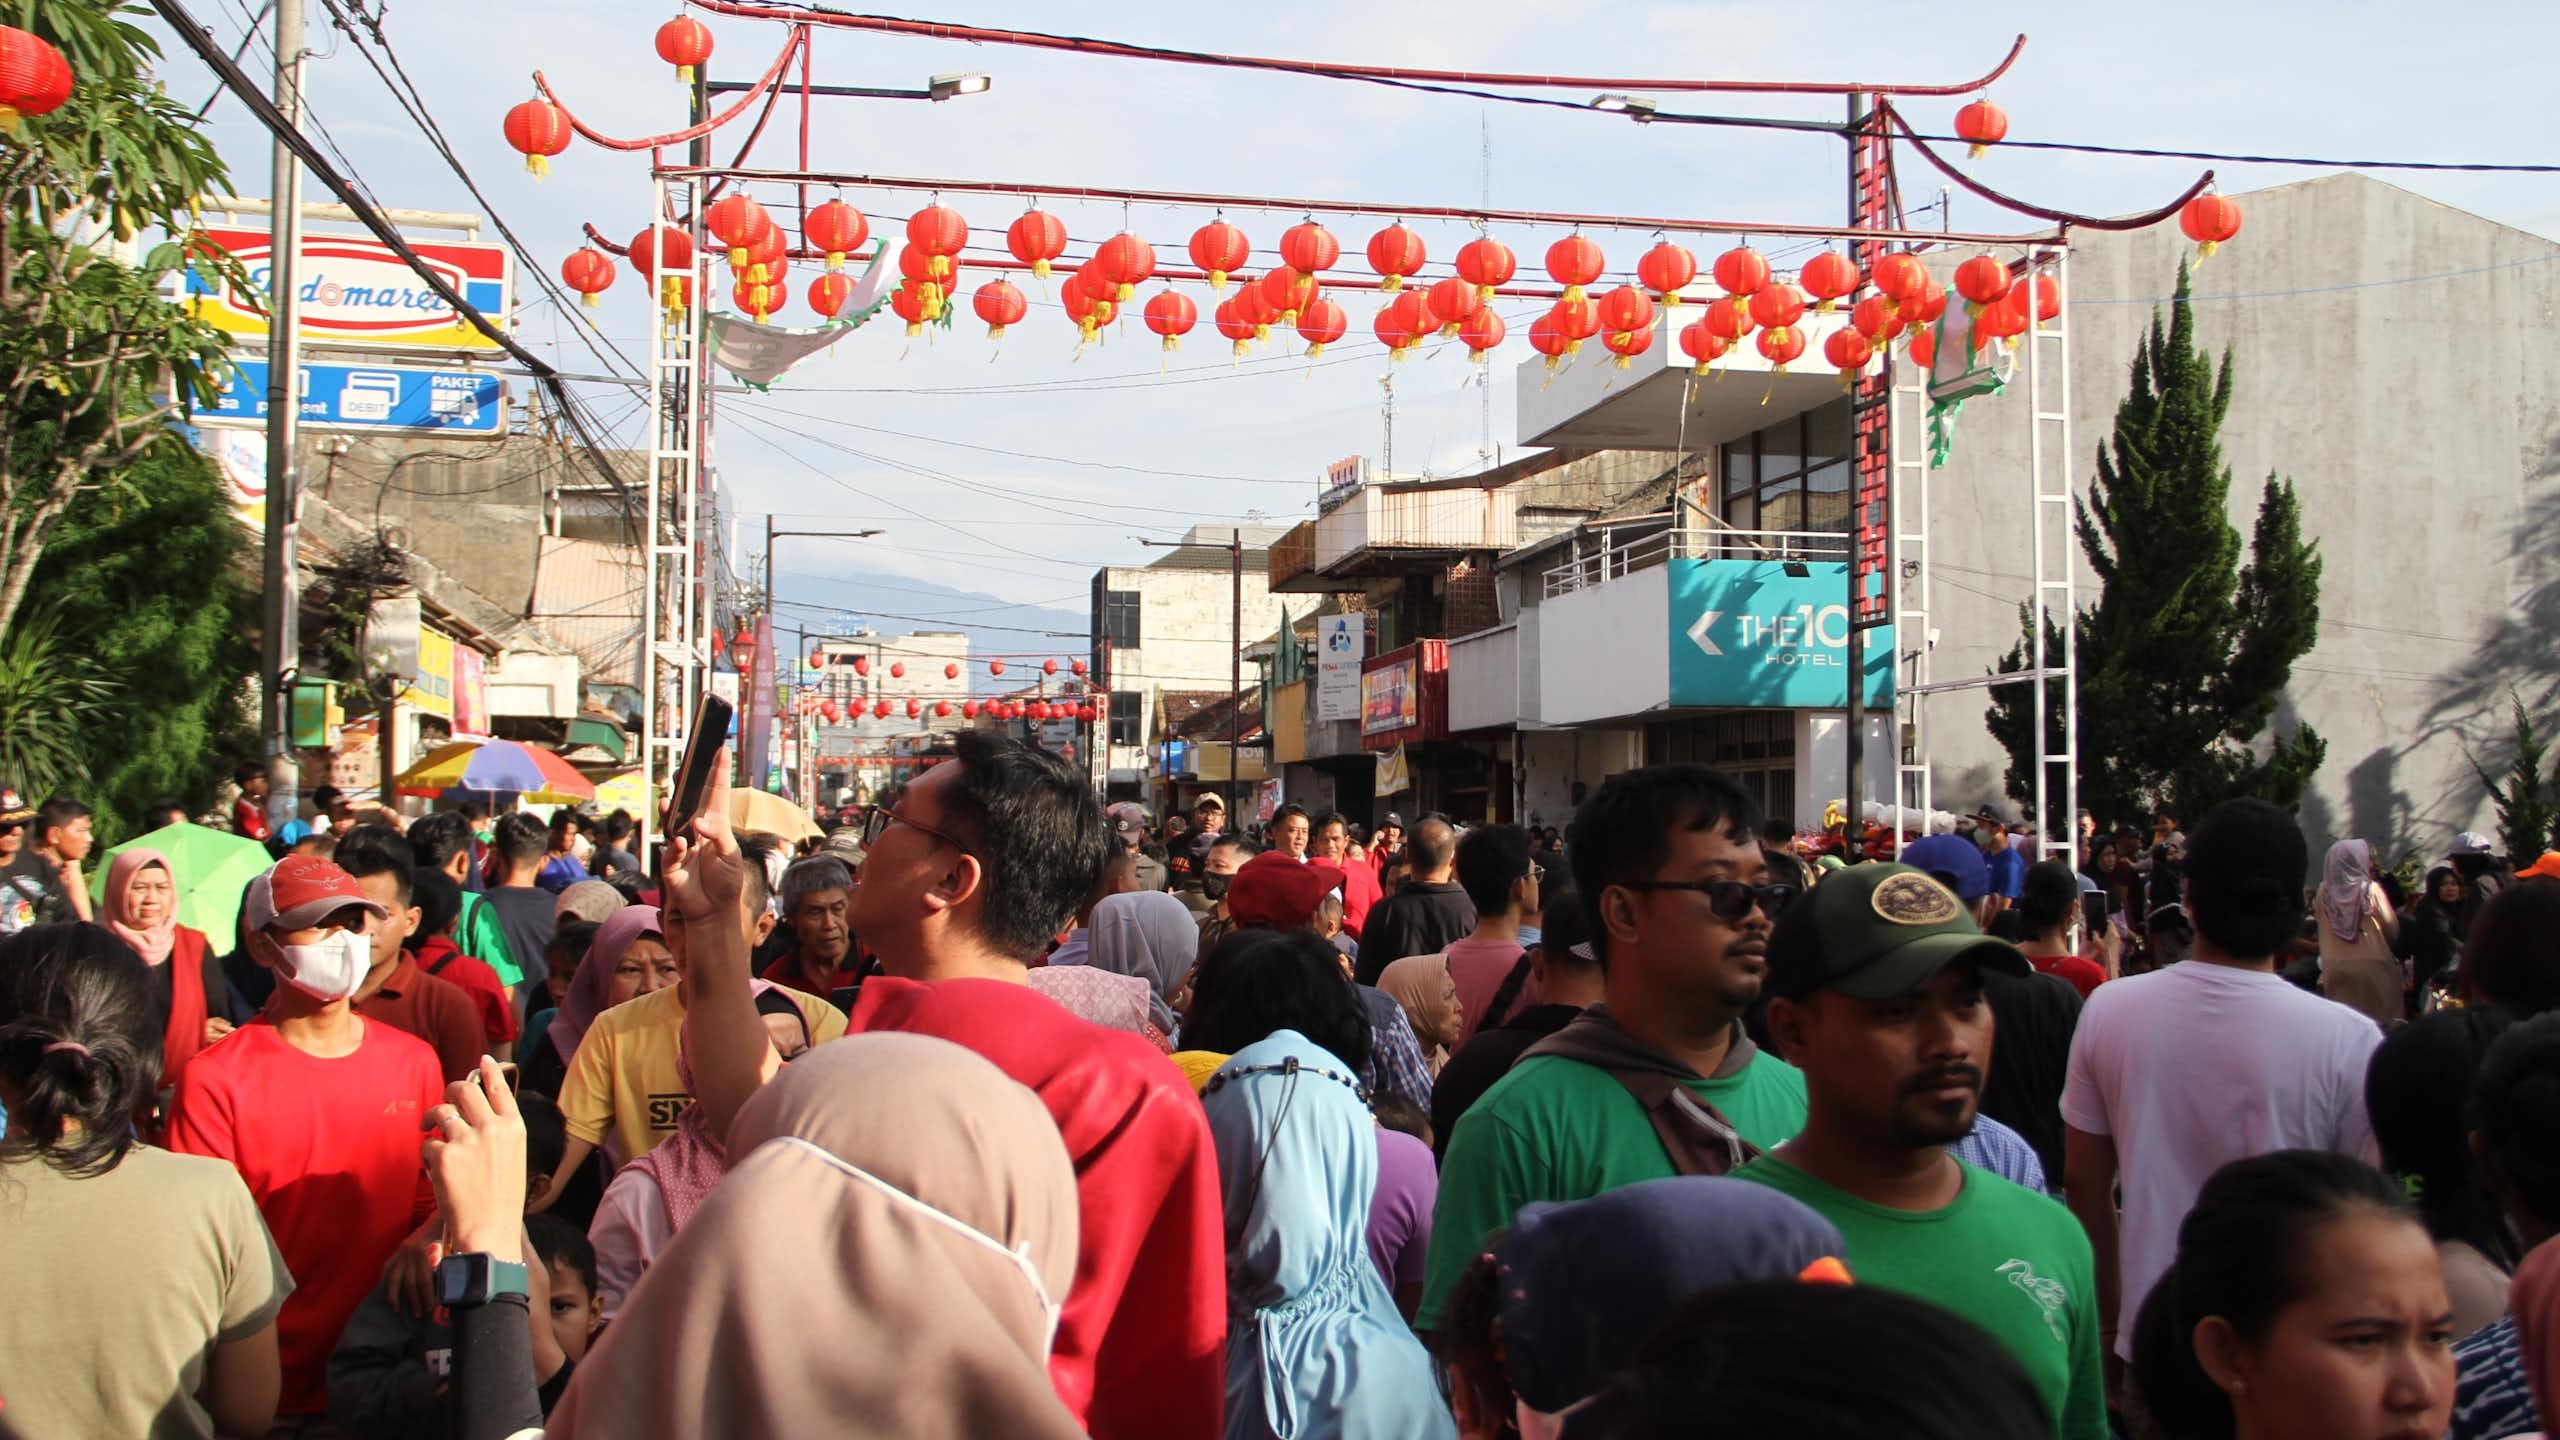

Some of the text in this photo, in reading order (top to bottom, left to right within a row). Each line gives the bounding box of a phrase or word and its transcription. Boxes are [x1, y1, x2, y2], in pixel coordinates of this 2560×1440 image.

[431, 375, 483, 390] PAKET
[256, 400, 329, 415] pent
[349, 401, 386, 413] DEBIT
[1737, 615, 1798, 648] THE
[1765, 653, 1842, 666] HOTEL
